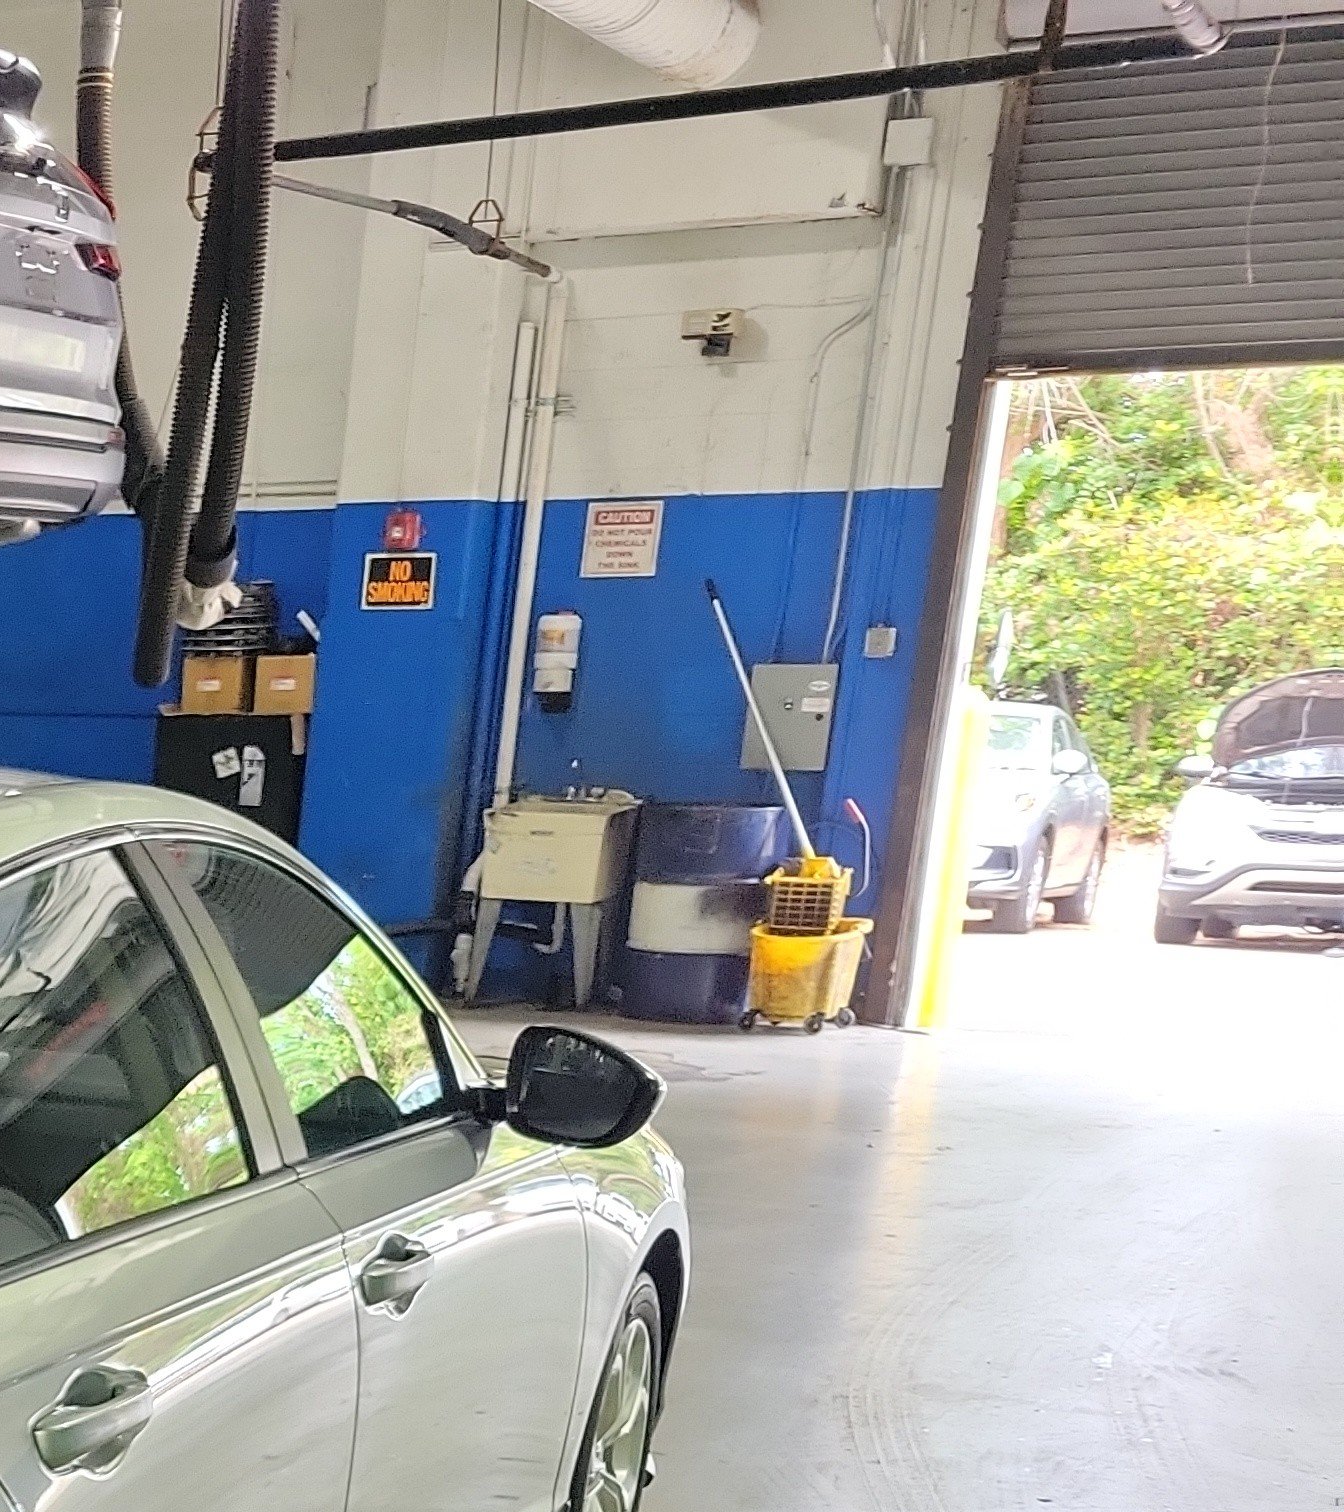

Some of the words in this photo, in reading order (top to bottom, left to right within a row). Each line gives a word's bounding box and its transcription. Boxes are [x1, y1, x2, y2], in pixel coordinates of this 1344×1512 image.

[598, 511, 652, 524] CAUTION
[607, 528, 626, 536] NOT
[628, 527, 652, 536] POUR
[595, 539, 647, 548] CHEMICALS
[606, 550, 633, 558] DOWN
[598, 561, 614, 569] THE
[389, 560, 412, 581] NO
[367, 581, 430, 603] SMOKING
